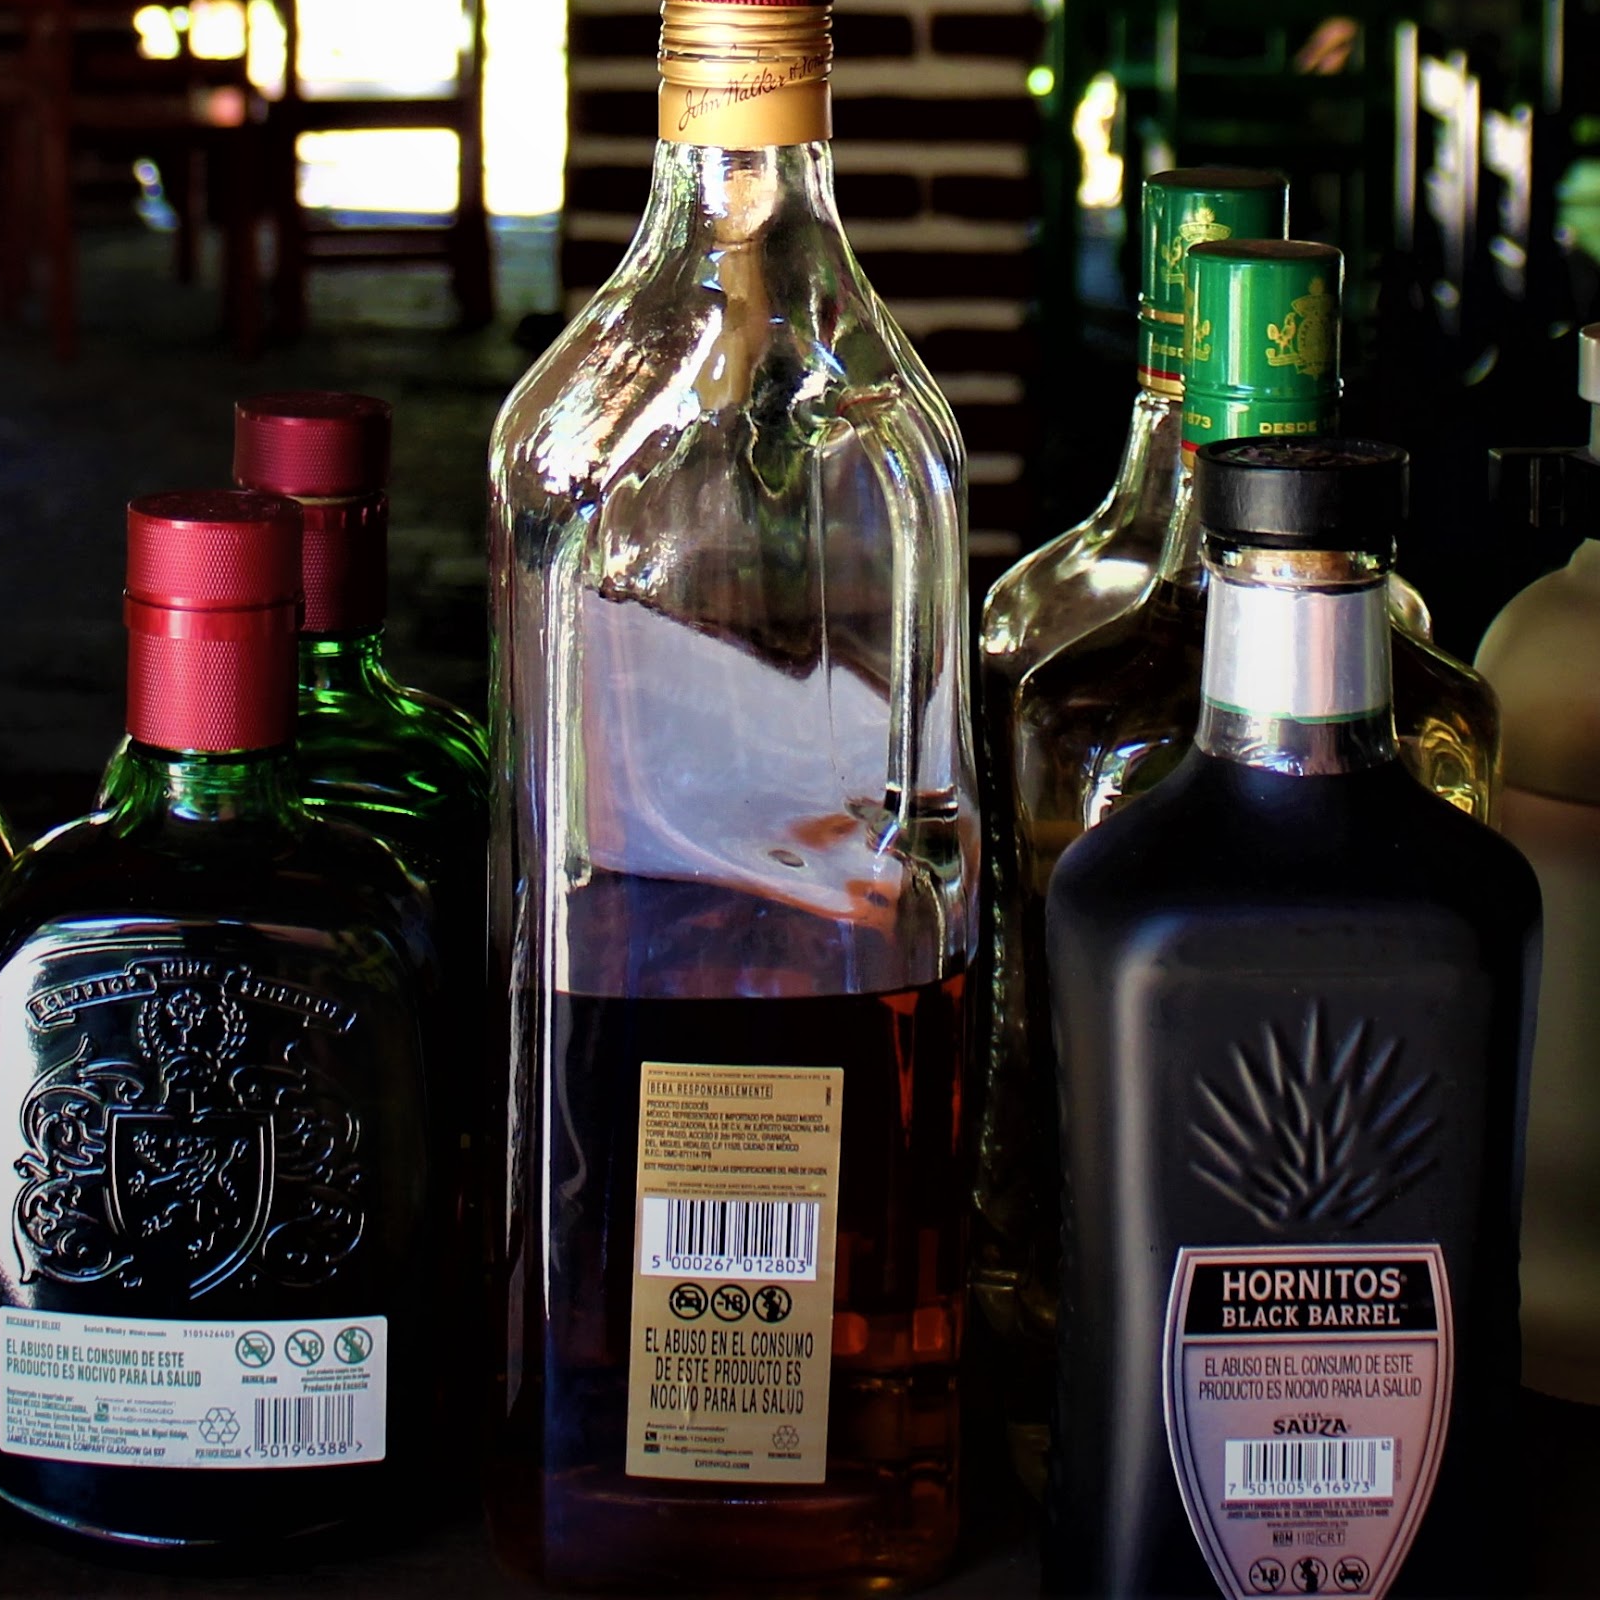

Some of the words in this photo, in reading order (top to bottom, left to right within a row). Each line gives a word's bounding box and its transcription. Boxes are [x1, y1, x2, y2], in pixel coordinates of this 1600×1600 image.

[1258, 420, 1318, 435] DESDE
[649, 1080, 674, 1094] BEBA
[676, 1082, 771, 1099] RESPONSABLEMENTE
[651, 1255, 661, 1269] 5
[670, 1256, 734, 1273] 000267
[743, 1257, 807, 1274] 012803
[1221, 1266, 1402, 1302] HORNITOS
[1221, 1303, 1301, 1329] BLACK
[1306, 1302, 1401, 1327] BARREL
[5, 1337, 17, 1356] EL
[19, 1340, 54, 1360] ABUSO
[55, 1343, 70, 1362] EN
[72, 1345, 85, 1363] EL
[86, 1346, 139, 1368] CONSUMO
[141, 1350, 154, 1368] DE
[157, 1350, 185, 1369] ESTE
[645, 1327, 660, 1353] EL
[664, 1327, 707, 1356] ABUSO
[711, 1330, 728, 1356] EN
[731, 1330, 746, 1357] EL
[750, 1331, 814, 1359] CONSUMO
[5, 1356, 60, 1379] PRODUCTO
[61, 1362, 76, 1380] ES
[77, 1364, 117, 1384] NOCIVO
[119, 1367, 148, 1386] PARA
[150, 1369, 165, 1387] LA
[166, 1369, 202, 1388] SALUD
[655, 1355, 672, 1382] DE
[676, 1356, 709, 1383] ESTE
[714, 1358, 783, 1386] PRODUCTO
[785, 1360, 802, 1387] ES
[1204, 1356, 1220, 1378] EL
[1221, 1356, 1262, 1378] ABUSO
[1264, 1355, 1281, 1377] EN
[1284, 1355, 1299, 1376] EL
[1300, 1354, 1363, 1376] CONSUMO
[1365, 1354, 1381, 1375] DE
[1384, 1353, 1414, 1374] ESTE
[649, 1383, 700, 1412] NOCIVO
[703, 1385, 737, 1413] PARA
[741, 1387, 757, 1414] LA
[761, 1388, 805, 1415] SALUD
[1199, 1377, 1264, 1402] PRODUCTO
[1266, 1378, 1282, 1400] ES
[1284, 1377, 1329, 1400] NOCIVO
[1331, 1377, 1363, 1399] PARA
[1365, 1376, 1380, 1398] LA
[1382, 1376, 1422, 1398] SALUD
[1272, 1417, 1348, 1438] SAUZA
[259, 1444, 301, 1459] 5019
[306, 1441, 348, 1457] 6388
[1228, 1482, 1236, 1496] 7
[1248, 1482, 1306, 1496] 501005
[1312, 1482, 1371, 1495] 616973
